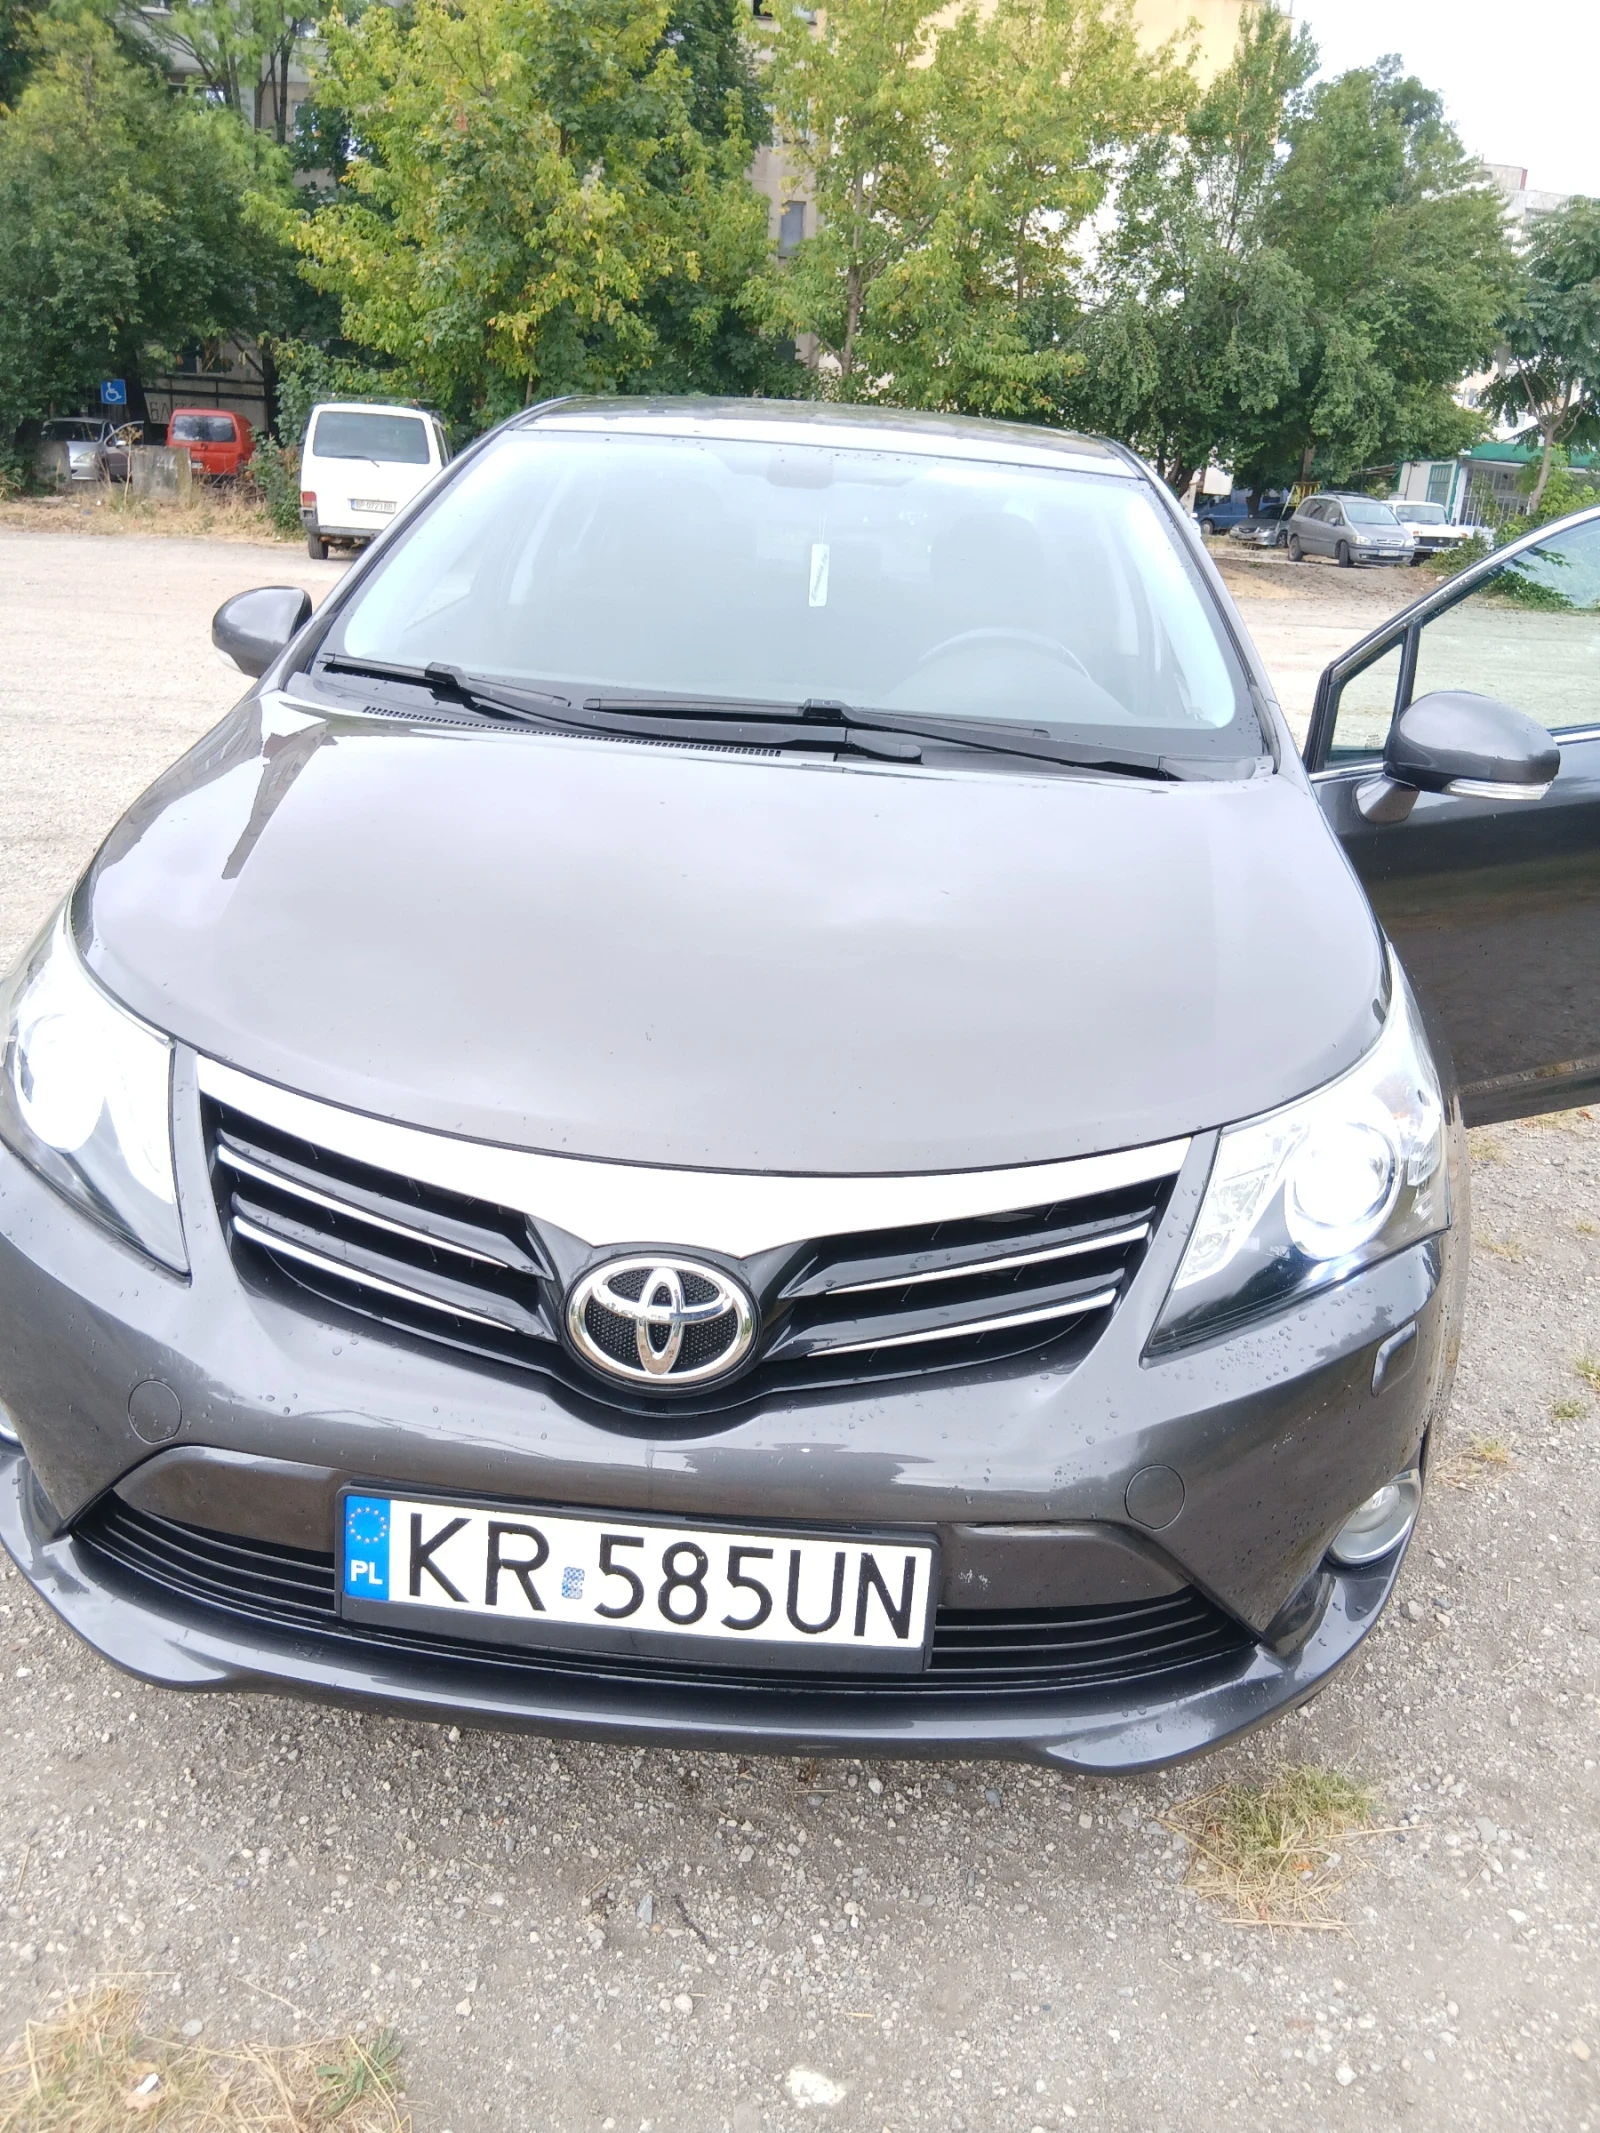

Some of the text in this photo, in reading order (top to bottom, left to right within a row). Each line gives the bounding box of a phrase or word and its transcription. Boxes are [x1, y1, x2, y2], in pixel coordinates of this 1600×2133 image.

[350, 1559, 383, 1585] PL
[408, 1512, 917, 1640] KR 585UN
